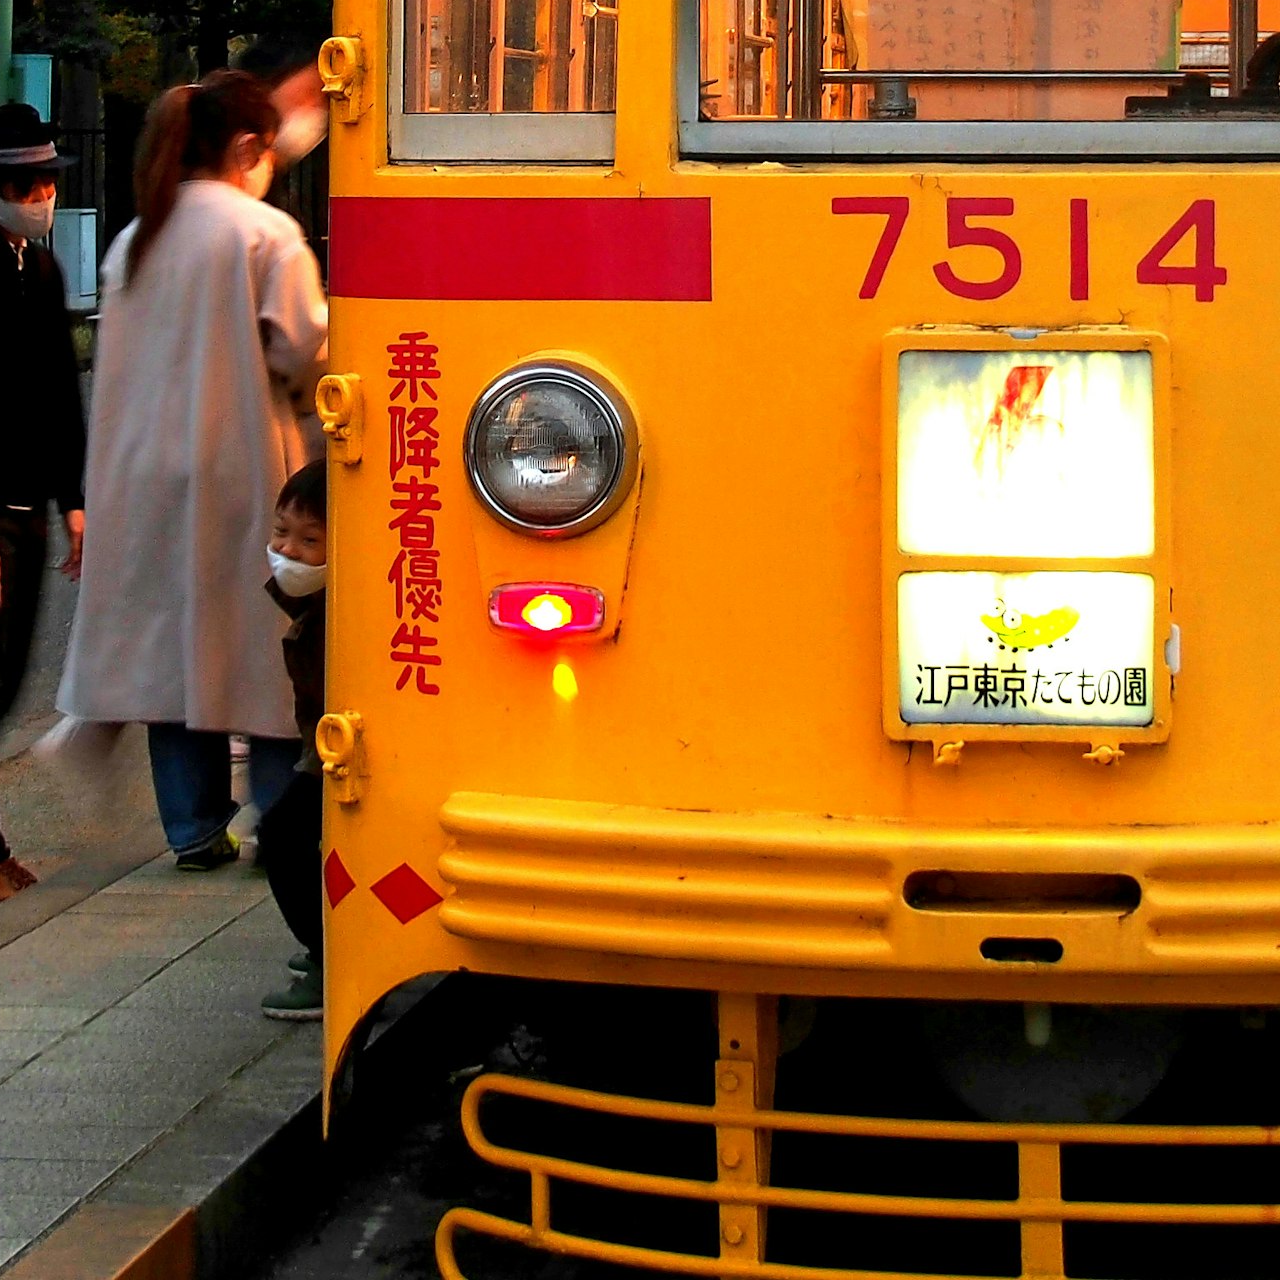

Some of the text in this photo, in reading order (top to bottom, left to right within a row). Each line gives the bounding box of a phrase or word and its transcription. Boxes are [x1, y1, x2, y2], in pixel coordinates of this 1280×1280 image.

[831, 196, 1227, 303] 7514
[386, 331, 443, 696] 乗降者優先
[915, 662, 1147, 709] 江戸東京たてもの園
